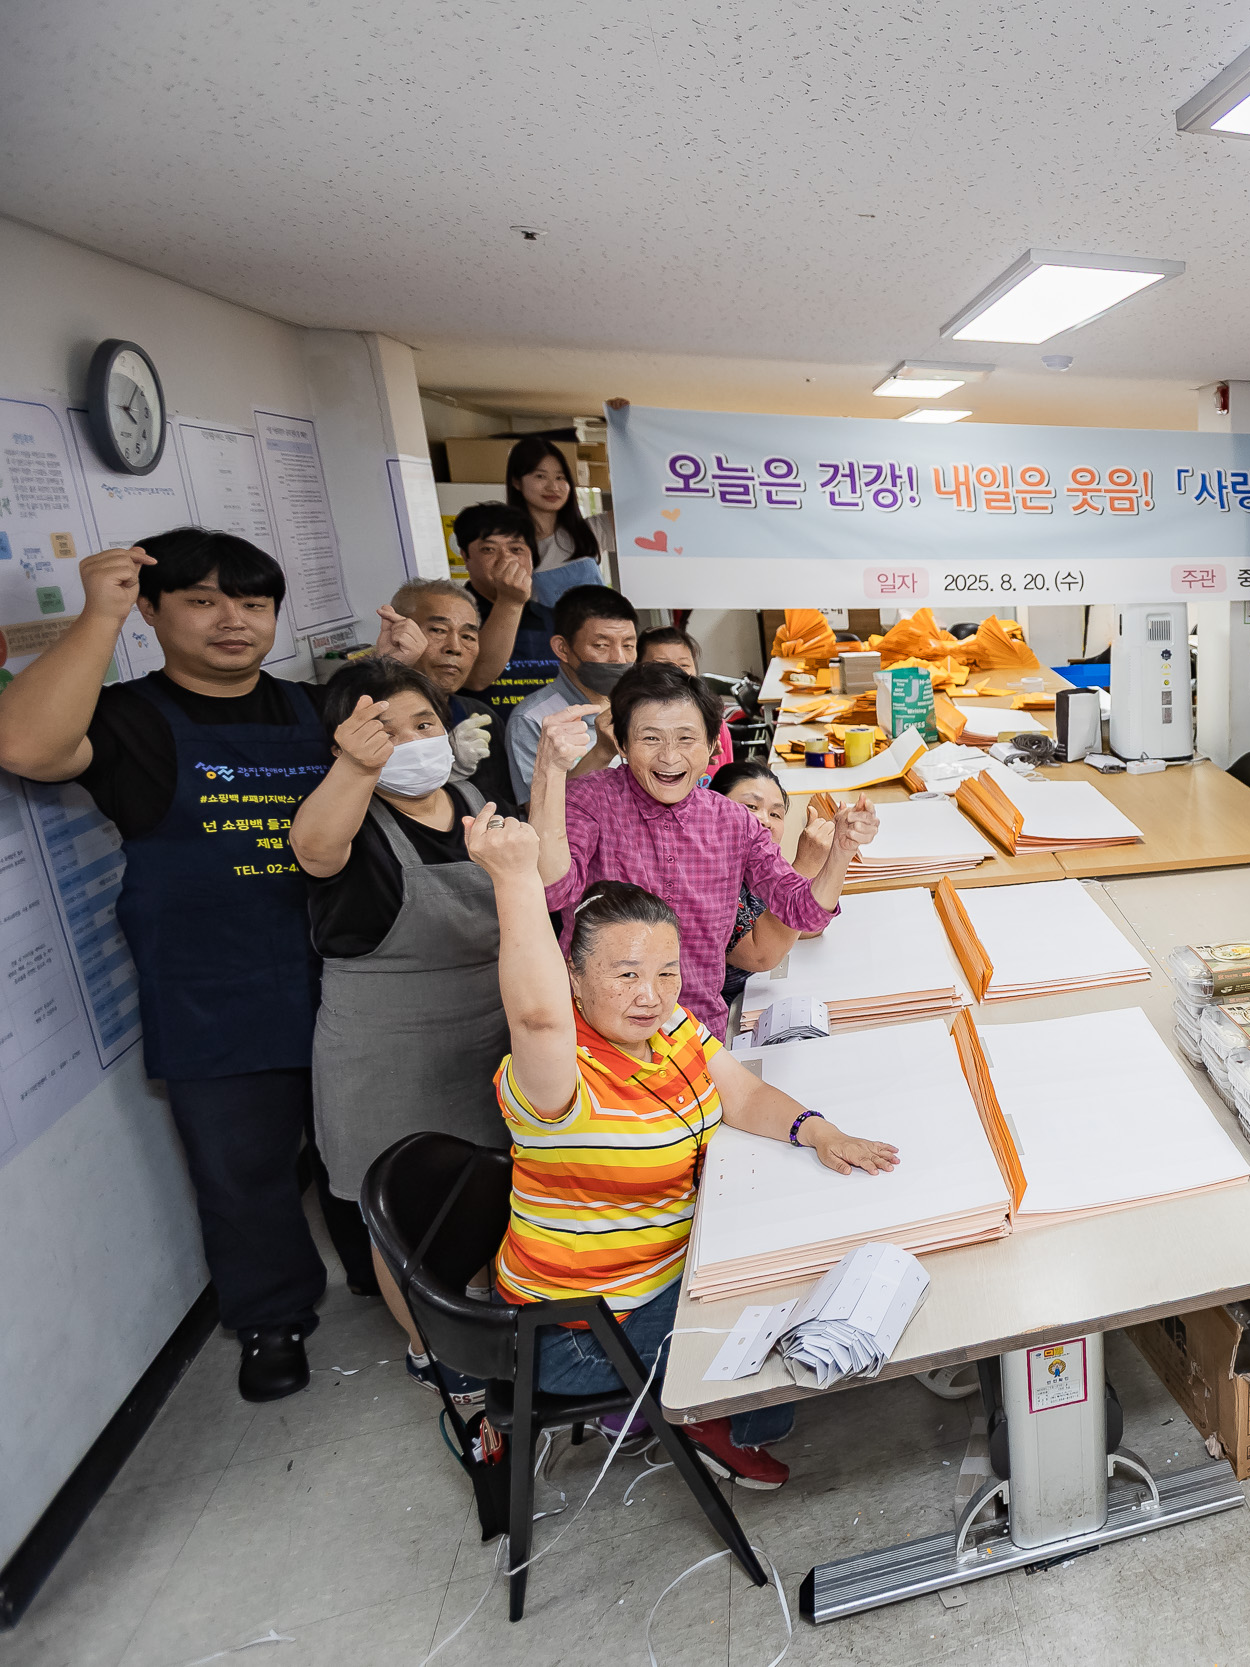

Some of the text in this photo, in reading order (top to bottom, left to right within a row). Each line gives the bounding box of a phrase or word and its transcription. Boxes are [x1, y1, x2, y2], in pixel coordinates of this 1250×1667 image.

[664, 453, 804, 509] 오늘은
[818, 460, 920, 511] 건강!
[931, 464, 1056, 513] 내일은
[1066, 467, 1155, 515] 웃음!
[876, 572, 919, 594] 일자
[944, 574, 994, 593] 2025.
[1000, 574, 1017, 593] 8.
[1181, 568, 1217, 588] 주관
[200, 794, 296, 804] #쇼핑백 #패키지박스
[203, 819, 291, 833] 넌 쇼핑백 들고
[256, 838, 283, 849] 제일
[234, 863, 299, 876] TEL. 02-4
